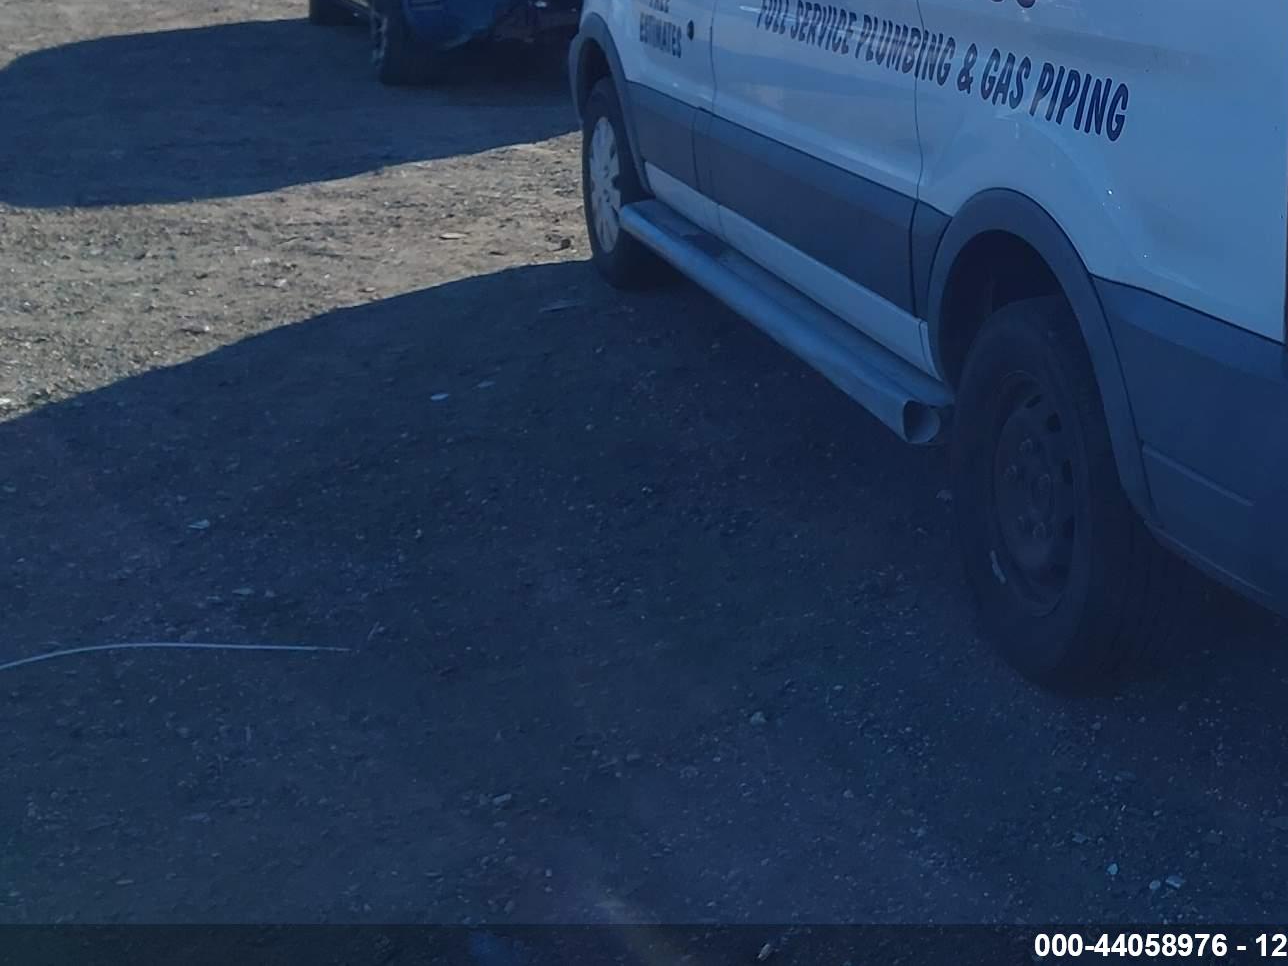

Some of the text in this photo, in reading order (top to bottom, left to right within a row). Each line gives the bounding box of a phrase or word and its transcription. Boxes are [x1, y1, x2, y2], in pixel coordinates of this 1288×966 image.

[855, 11, 955, 86] PLUMBING
[957, 44, 979, 93] &
[980, 48, 1030, 111] GAS
[1030, 62, 1130, 142] PIPING
